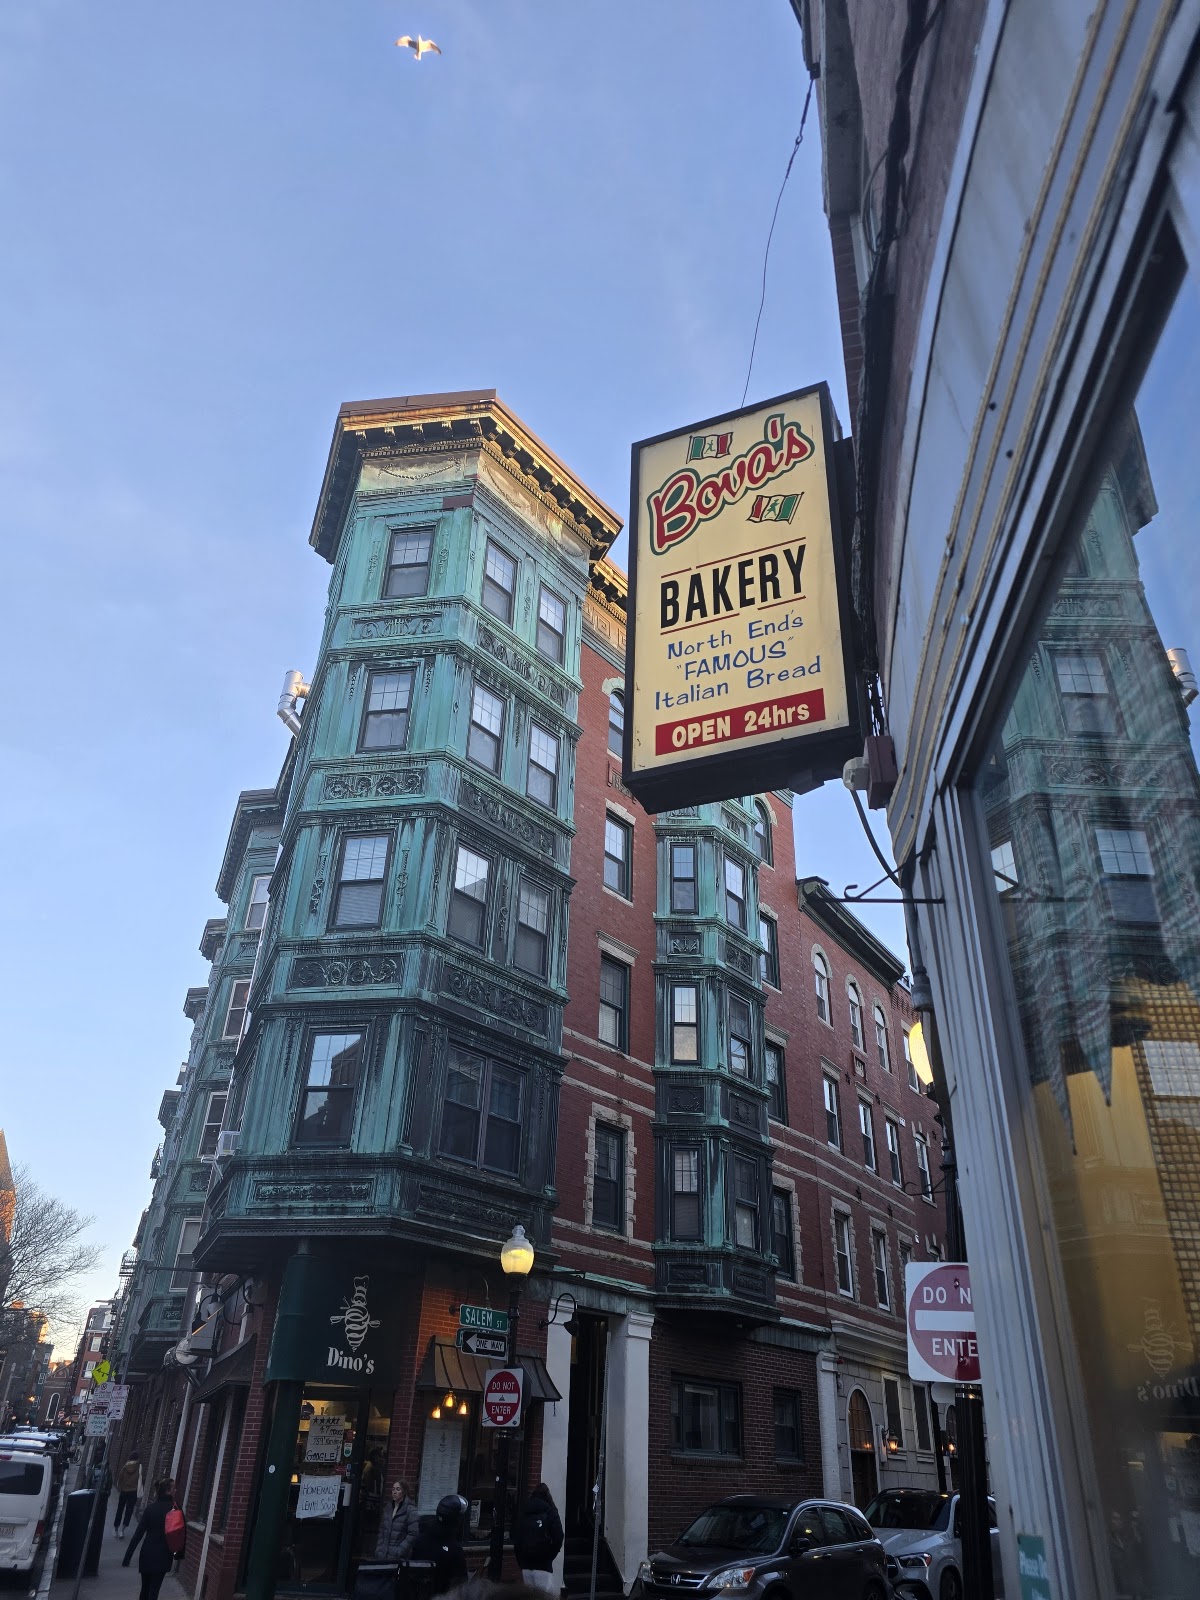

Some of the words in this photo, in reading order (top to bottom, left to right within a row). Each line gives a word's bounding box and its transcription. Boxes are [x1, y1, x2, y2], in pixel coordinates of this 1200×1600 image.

[647, 414, 815, 555] Bova's
[660, 544, 807, 630] BAKERY
[667, 630, 733, 661] North
[748, 609, 804, 639] End's
[676, 637, 794, 680] "FAMOUS"
[655, 682, 729, 711] Italian
[747, 656, 821, 689] Bread
[671, 715, 731, 748] OPEN
[744, 703, 810, 733] 24hrs
[923, 1286, 947, 1304] DO
[465, 1307, 493, 1327] SALEM
[496, 1320, 503, 1328] ST
[476, 1339, 488, 1349] ONE
[491, 1341, 504, 1350] WAY
[932, 1338, 979, 1357] ENTE
[326, 1346, 375, 1375] Dino's
[492, 1381, 501, 1390] DO
[502, 1381, 515, 1391] NOT
[491, 1405, 511, 1415] ENTER
[303, 1483, 338, 1496] HOMEMADE
